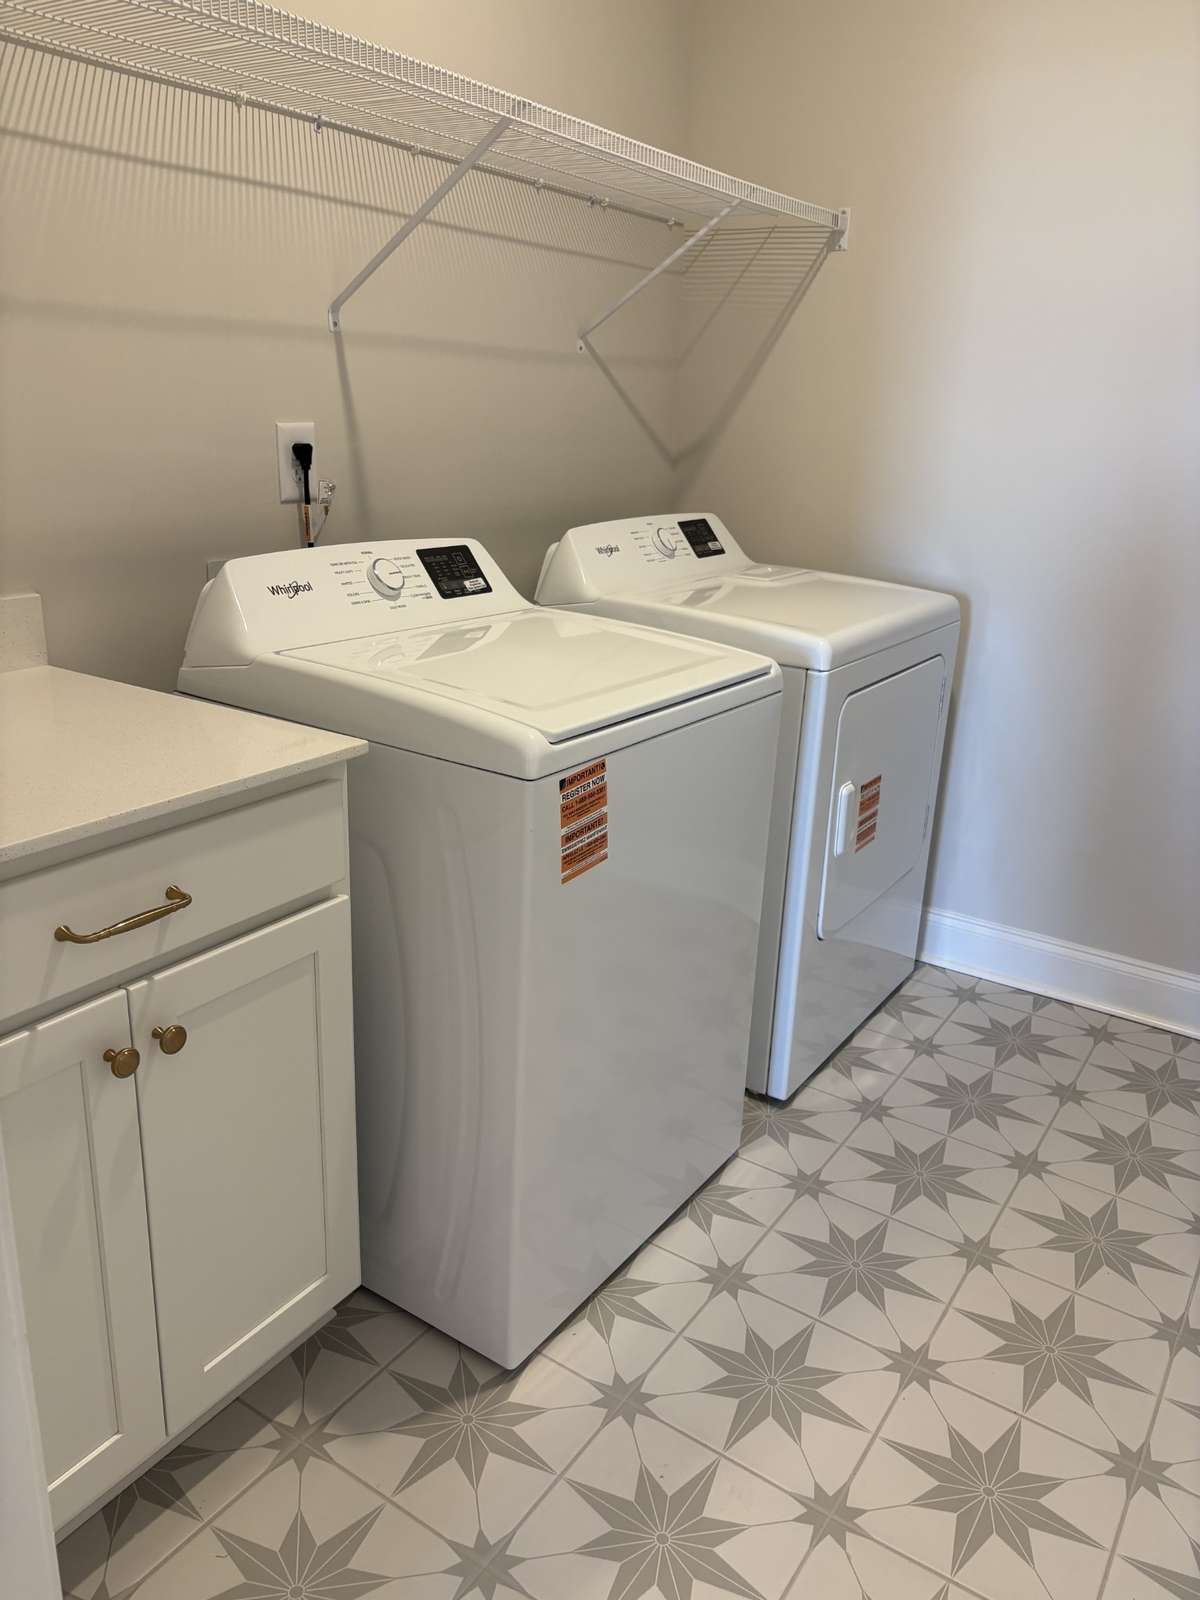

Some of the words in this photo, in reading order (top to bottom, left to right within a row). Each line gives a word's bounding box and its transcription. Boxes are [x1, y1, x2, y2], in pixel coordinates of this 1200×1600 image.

[266, 580, 313, 600] Whirlpool
[561, 781, 591, 802] REGISTER
[592, 774, 606, 787] NOW
